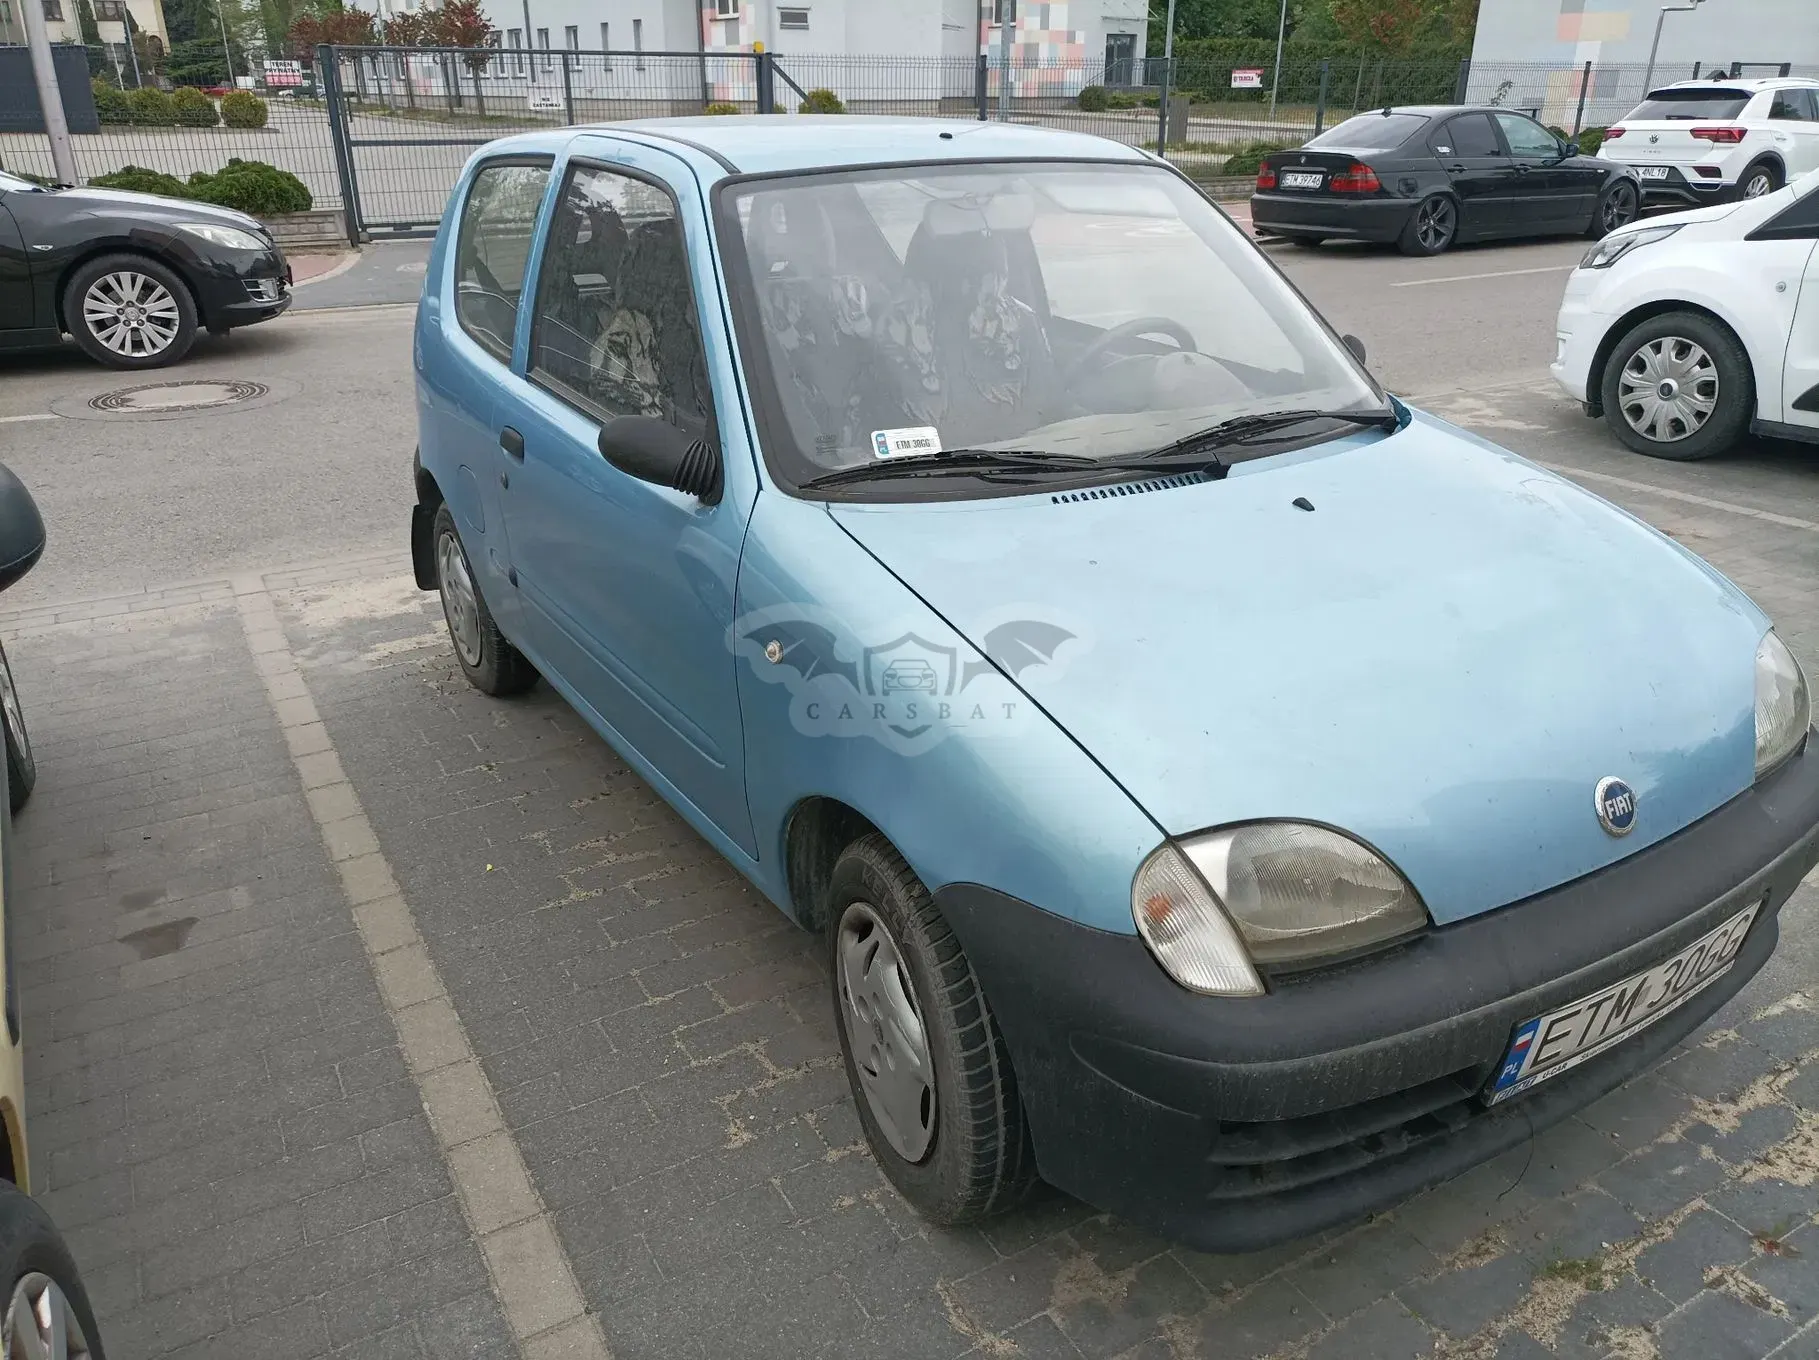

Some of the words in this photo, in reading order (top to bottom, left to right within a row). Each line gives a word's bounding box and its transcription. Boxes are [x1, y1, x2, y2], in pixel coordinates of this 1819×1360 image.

[1285, 174, 1299, 185] ETM
[1299, 175, 1321, 186] 39746
[1605, 792, 1632, 820] FIAT
[1530, 975, 1649, 1070] ETM
[1501, 1062, 1518, 1079] PL
